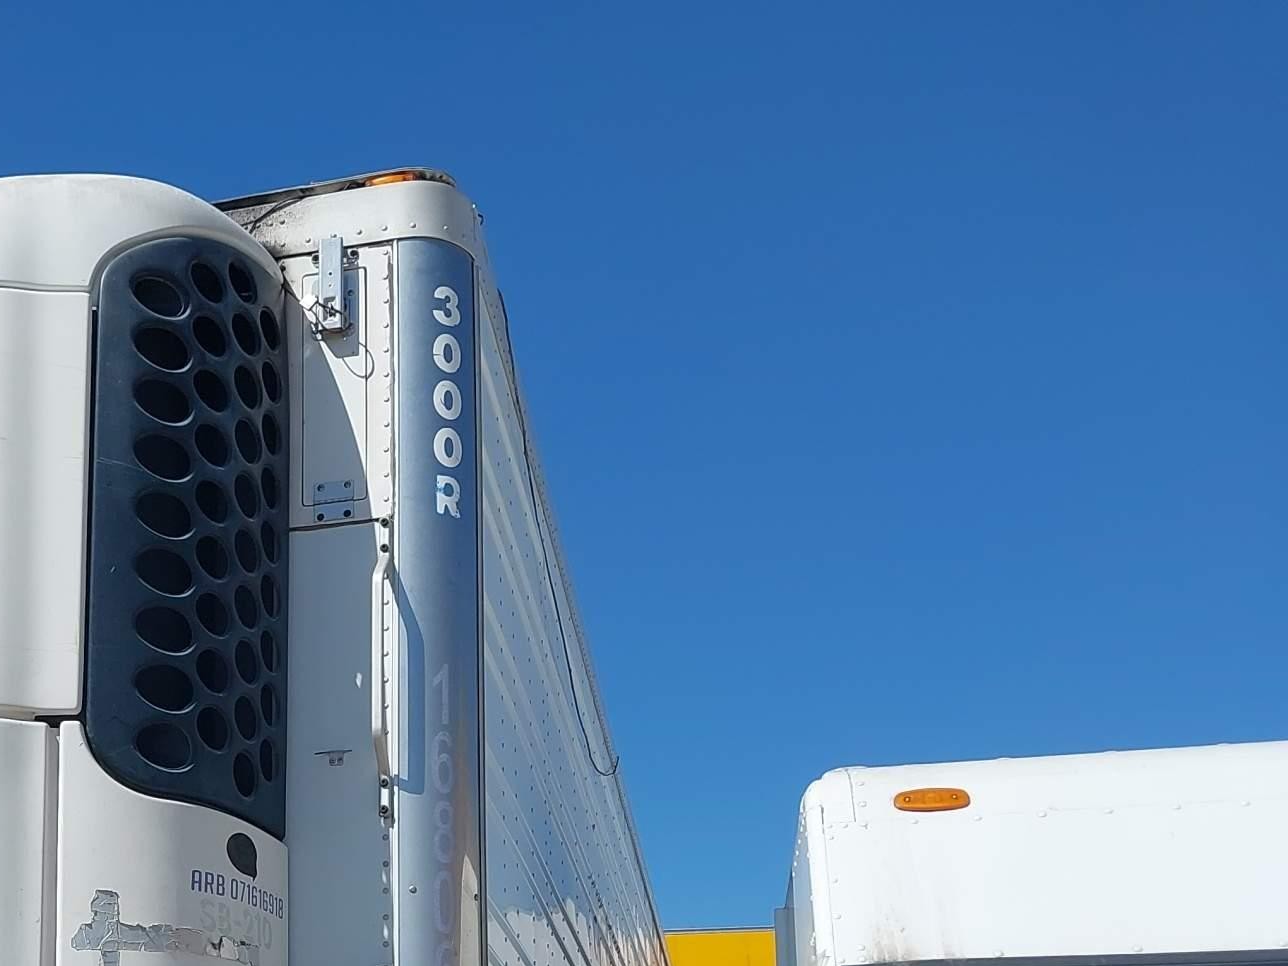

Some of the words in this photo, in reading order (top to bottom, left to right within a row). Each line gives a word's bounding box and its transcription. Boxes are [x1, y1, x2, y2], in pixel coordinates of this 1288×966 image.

[432, 285, 462, 518] 3000R
[191, 869, 226, 897] ARB
[230, 878, 284, 920] 071616918
